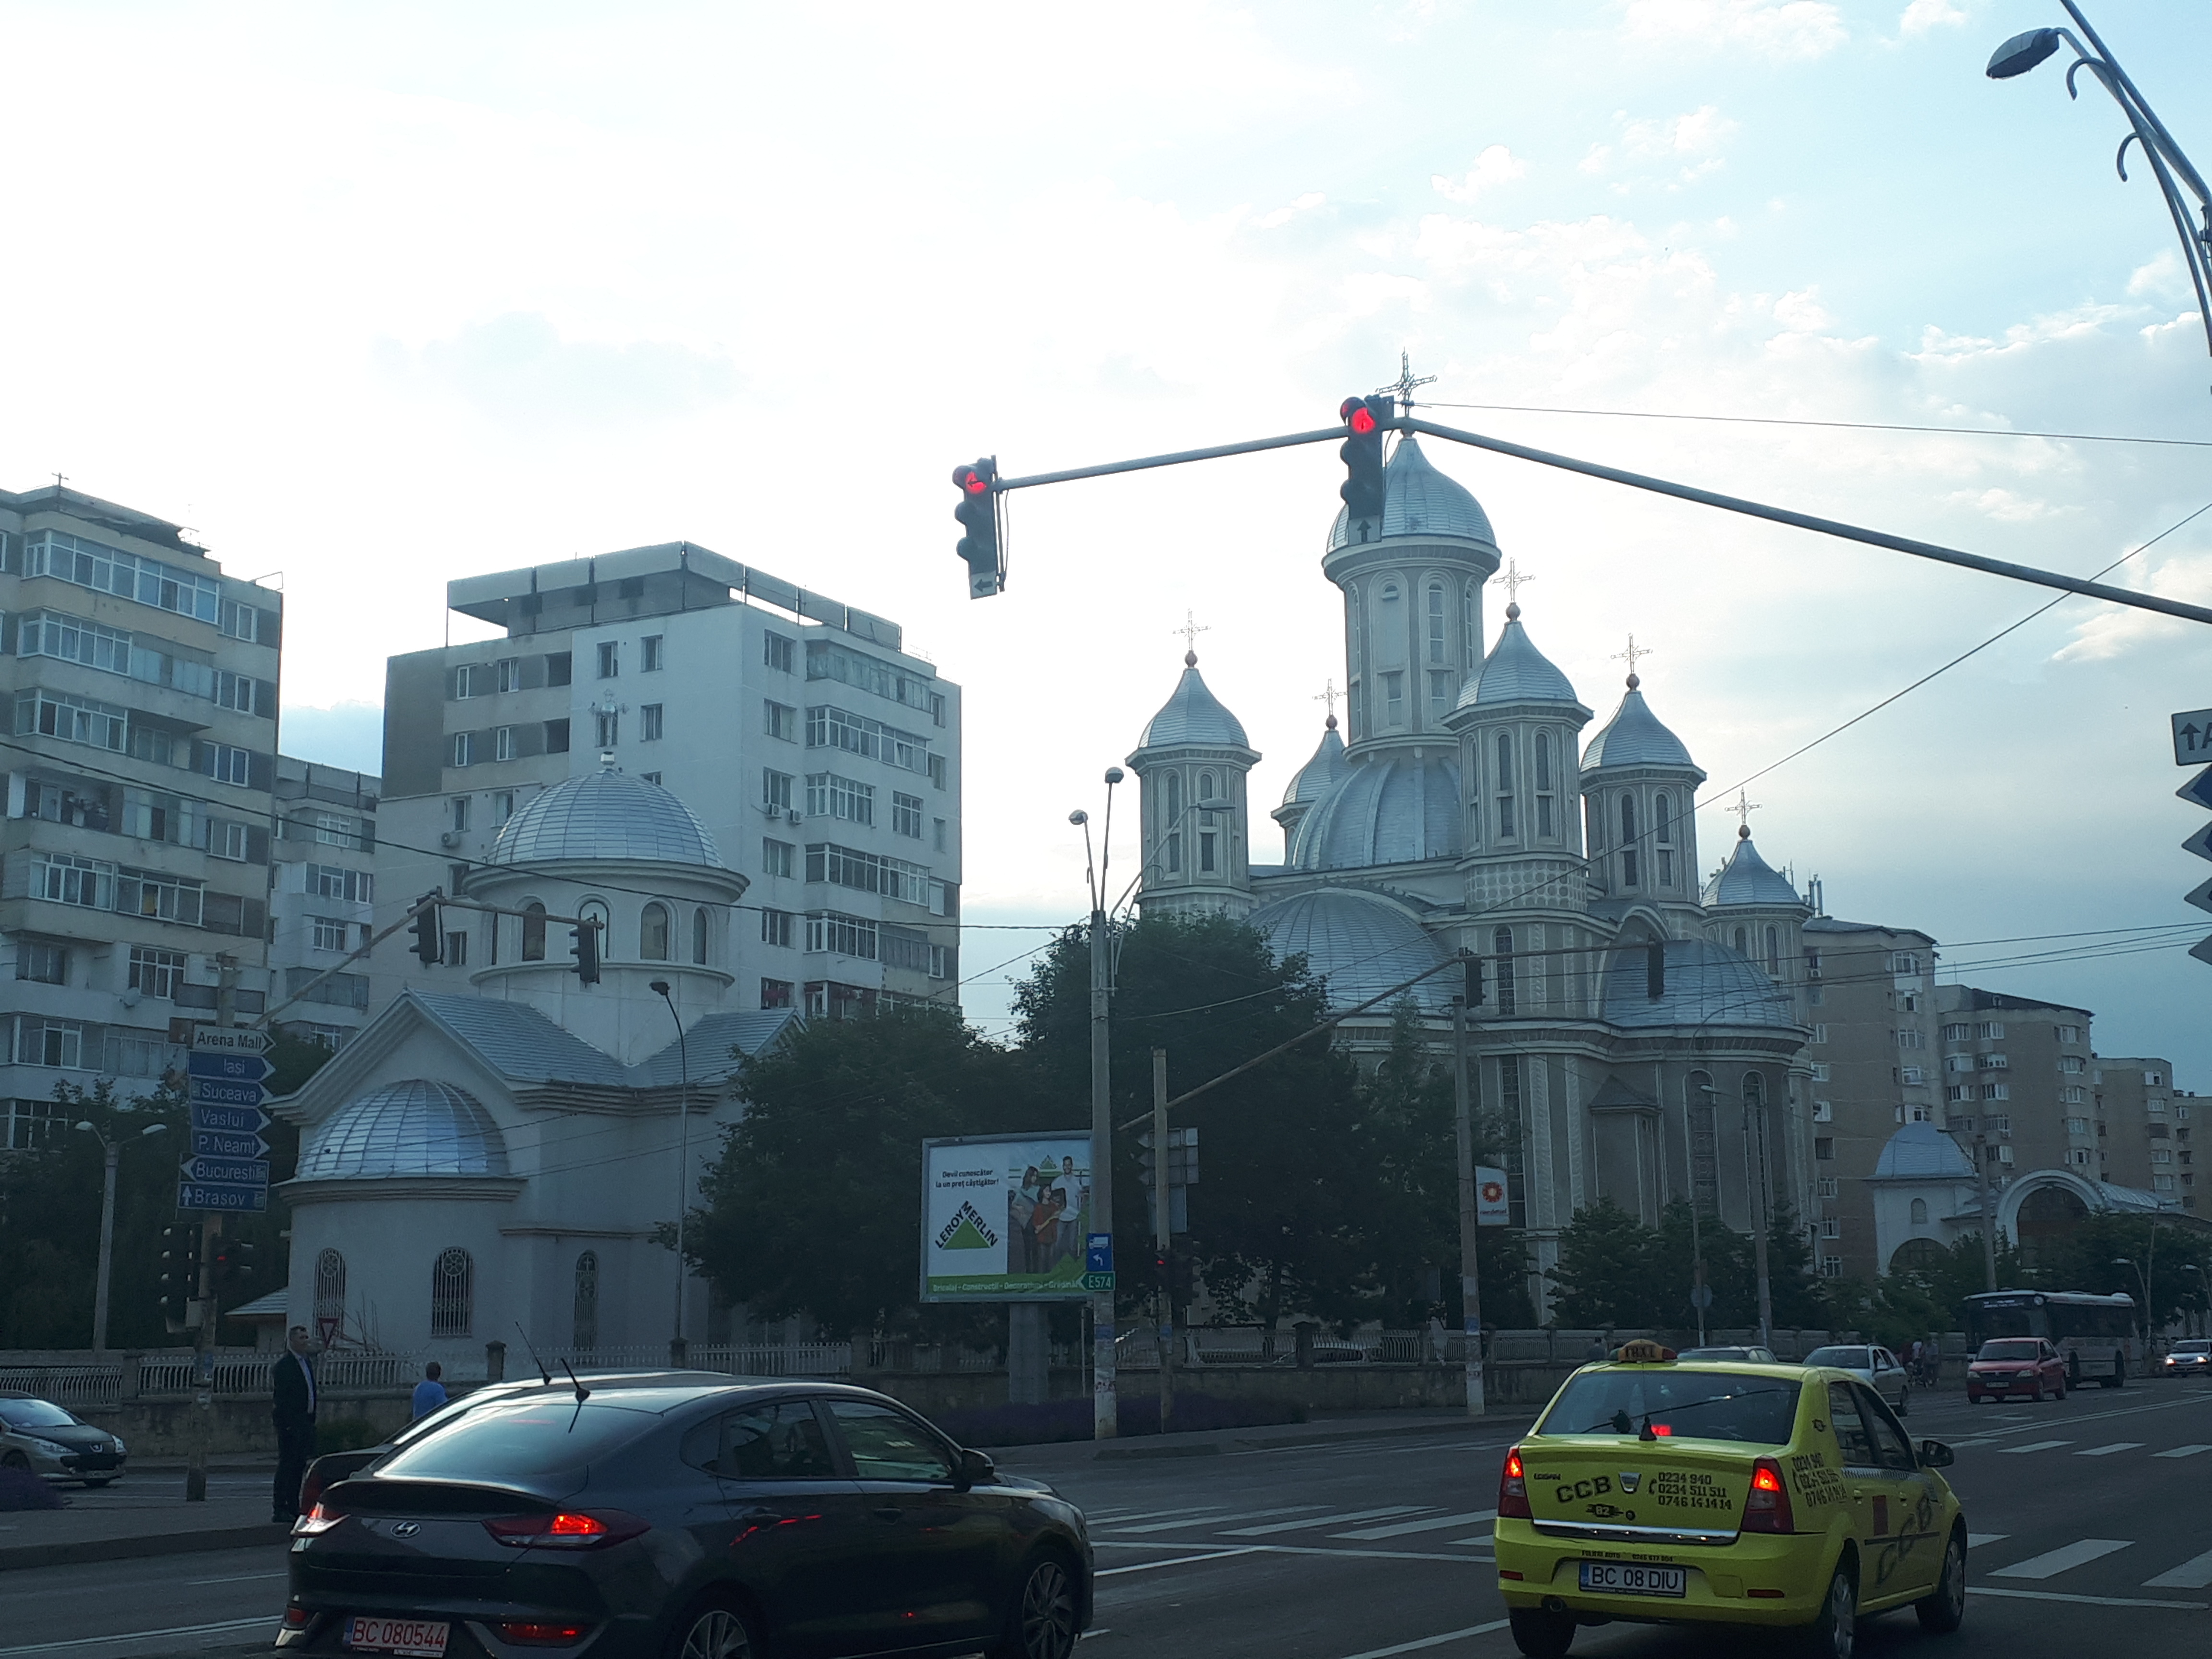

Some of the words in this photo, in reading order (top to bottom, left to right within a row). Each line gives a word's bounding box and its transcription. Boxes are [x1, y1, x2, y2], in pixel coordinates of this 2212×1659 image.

[197, 1032, 233, 1047] Arena
[238, 1034, 262, 1049] Mall
[201, 1083, 256, 1102] Suceava
[201, 1109, 244, 1127] Vaslui
[198, 1135, 209, 1150] P.
[935, 1209, 965, 1249] LEROY
[961, 1201, 998, 1246] MERLIN
[1658, 1472, 1687, 1483] 0234
[1556, 1476, 1612, 1503] CCB
[1658, 1483, 1687, 1495] 0234
[1690, 1486, 1707, 1497] 511
[1709, 1487, 1727, 1498] 511
[1658, 1495, 1688, 1507] 0746
[1592, 1566, 1617, 1585] BC
[1624, 1569, 1644, 1587] 08
[1648, 1571, 1678, 1589] DIU
[352, 1621, 379, 1643] BC
[382, 1623, 446, 1648] 080544
